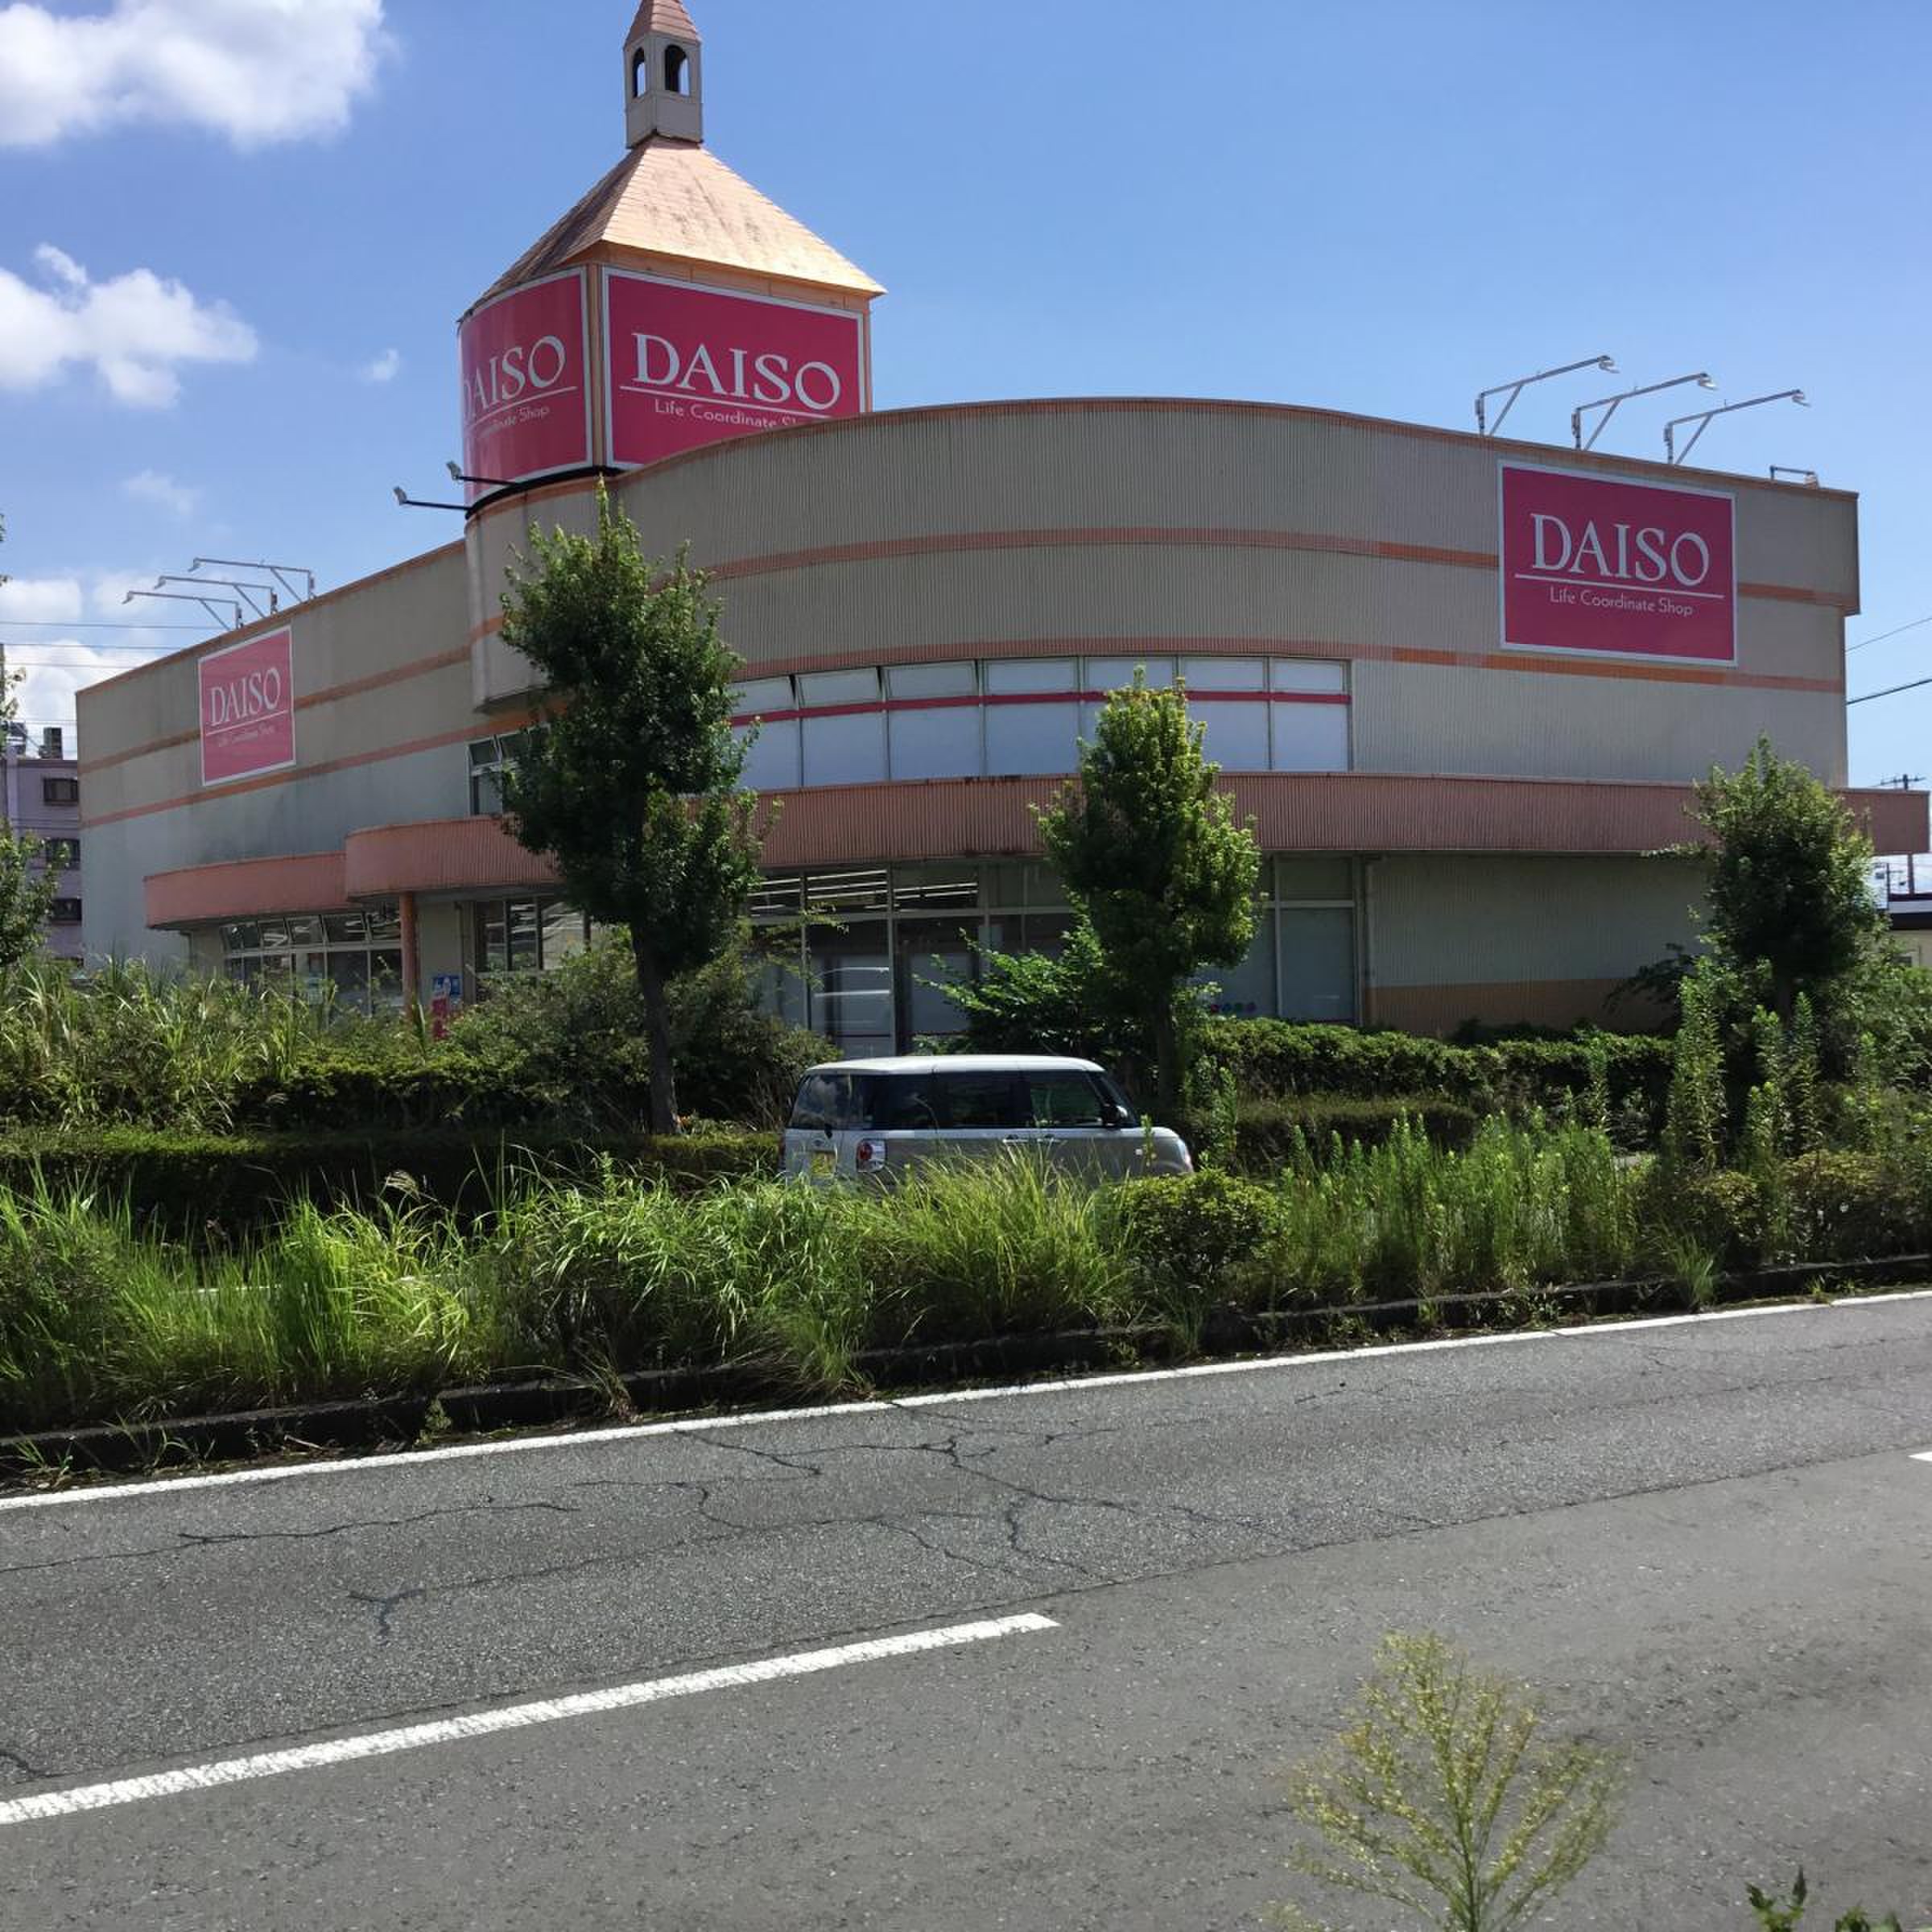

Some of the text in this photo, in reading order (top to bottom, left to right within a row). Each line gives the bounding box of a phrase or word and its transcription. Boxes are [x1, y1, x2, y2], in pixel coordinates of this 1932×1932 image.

[631, 332, 841, 411] DAISO
[654, 399, 684, 417] Life
[690, 404, 777, 428] Coordinate
[1530, 513, 1710, 586] DAISO
[1550, 586, 1692, 617] Life Coordinate Shop
[209, 667, 281, 726] DAISO
